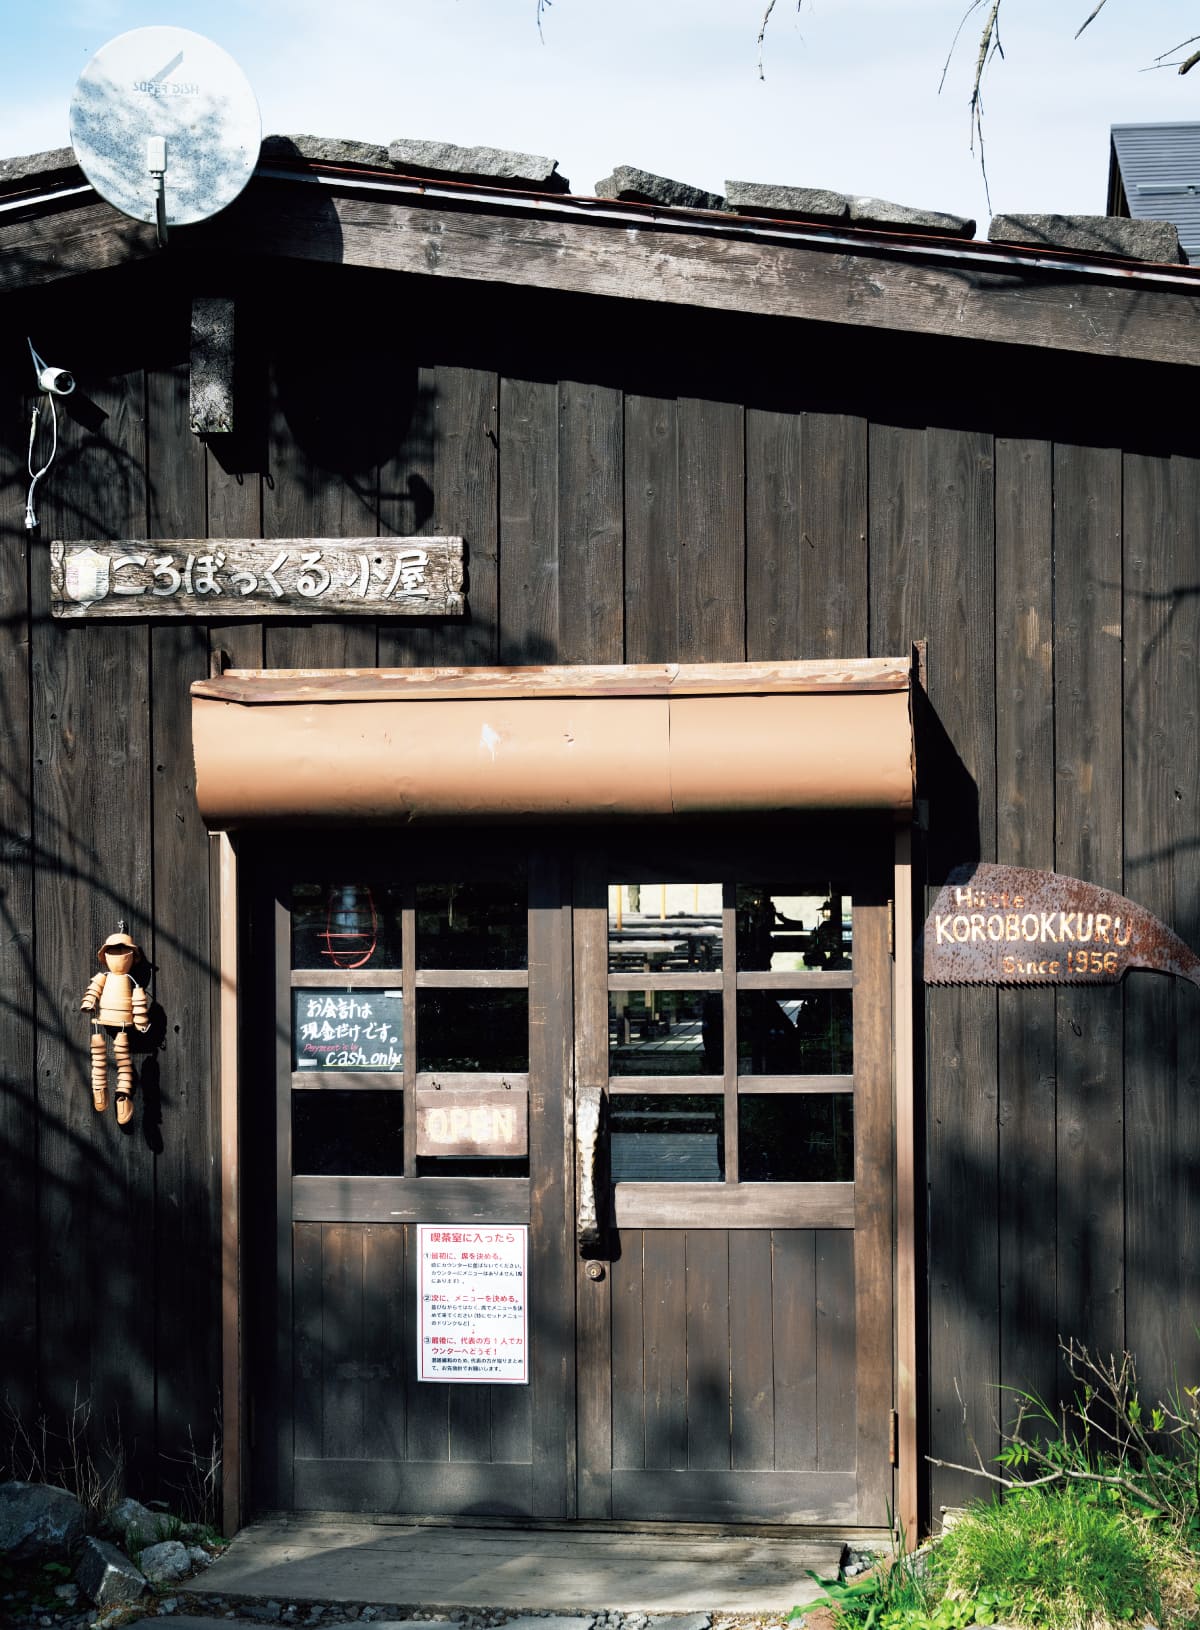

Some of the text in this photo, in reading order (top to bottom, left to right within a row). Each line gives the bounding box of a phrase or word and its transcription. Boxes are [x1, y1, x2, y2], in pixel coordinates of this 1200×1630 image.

[112, 549, 430, 598] ころぼっくる小屋
[935, 912, 1132, 946] KOROBOKKURU
[1003, 951, 1119, 975] Since 1956
[307, 997, 373, 1019] お会計は
[300, 1020, 398, 1043] 現金だけです。
[325, 1046, 402, 1071] cash only
[428, 1108, 514, 1143] OPEN
[430, 1232, 516, 1243] 喫茶室に入ったら
